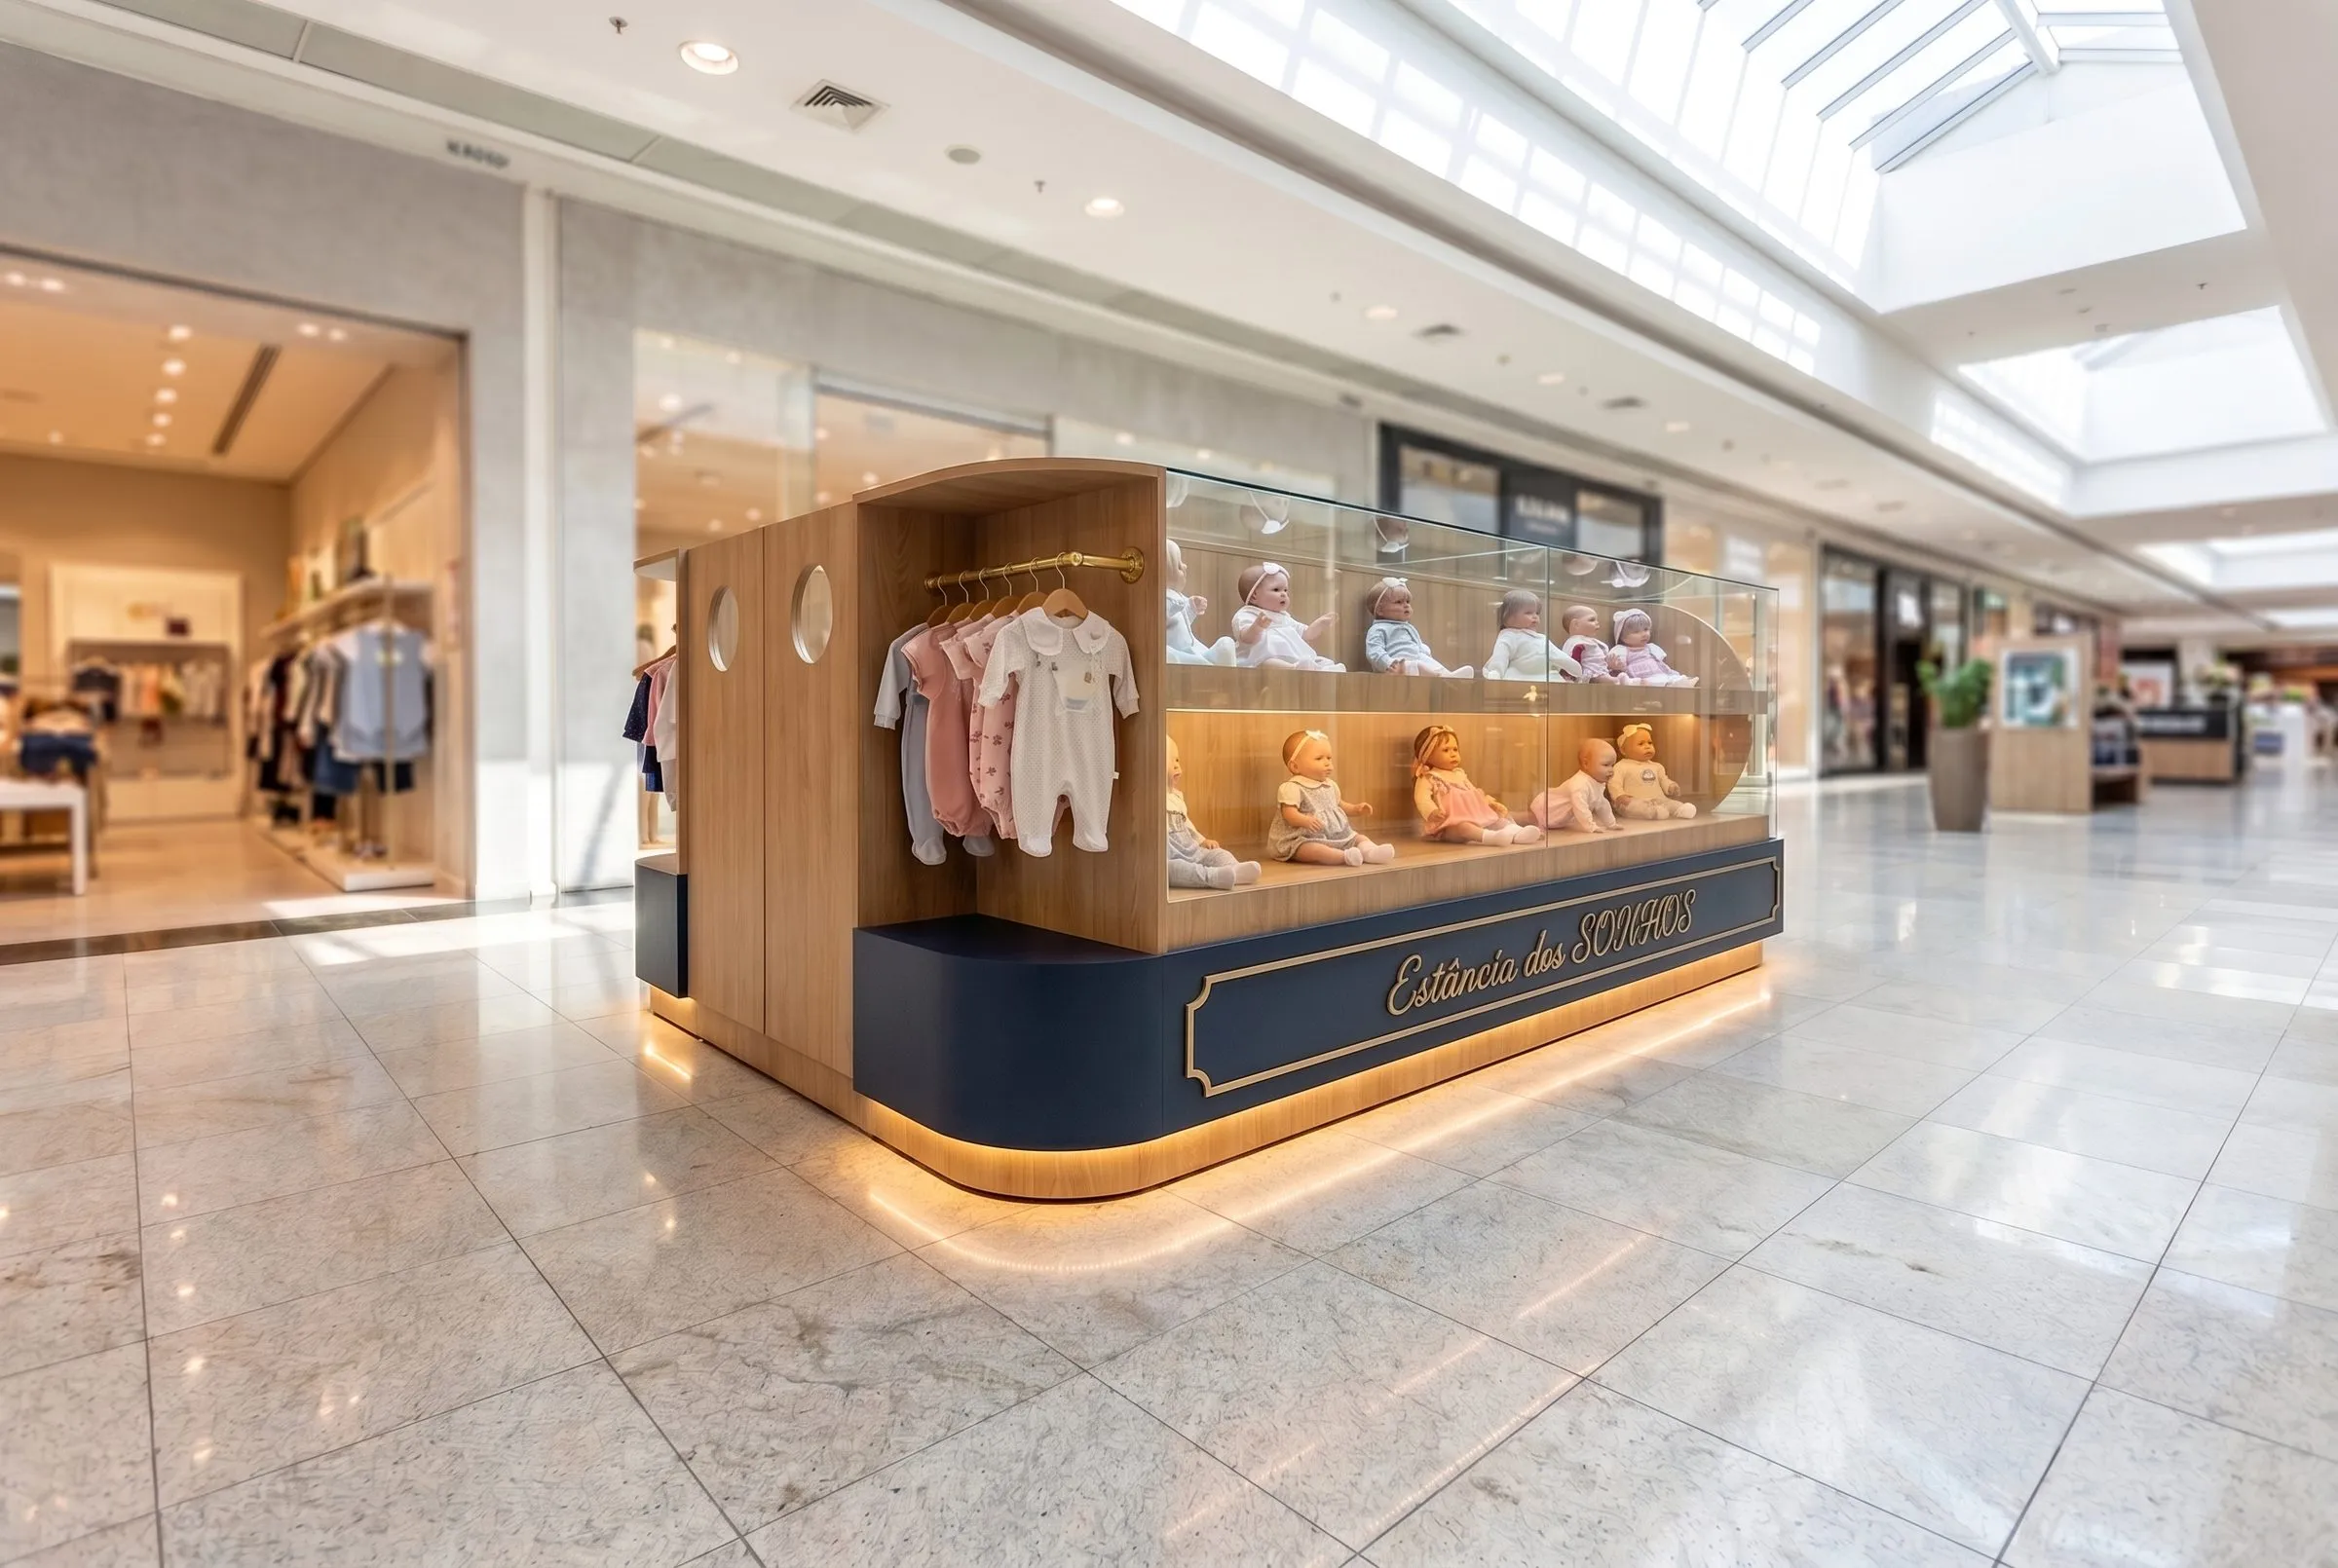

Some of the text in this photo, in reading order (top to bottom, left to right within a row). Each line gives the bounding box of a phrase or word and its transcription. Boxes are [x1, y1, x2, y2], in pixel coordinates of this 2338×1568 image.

[1386, 888, 1697, 1017] Estância dos SONHOS
